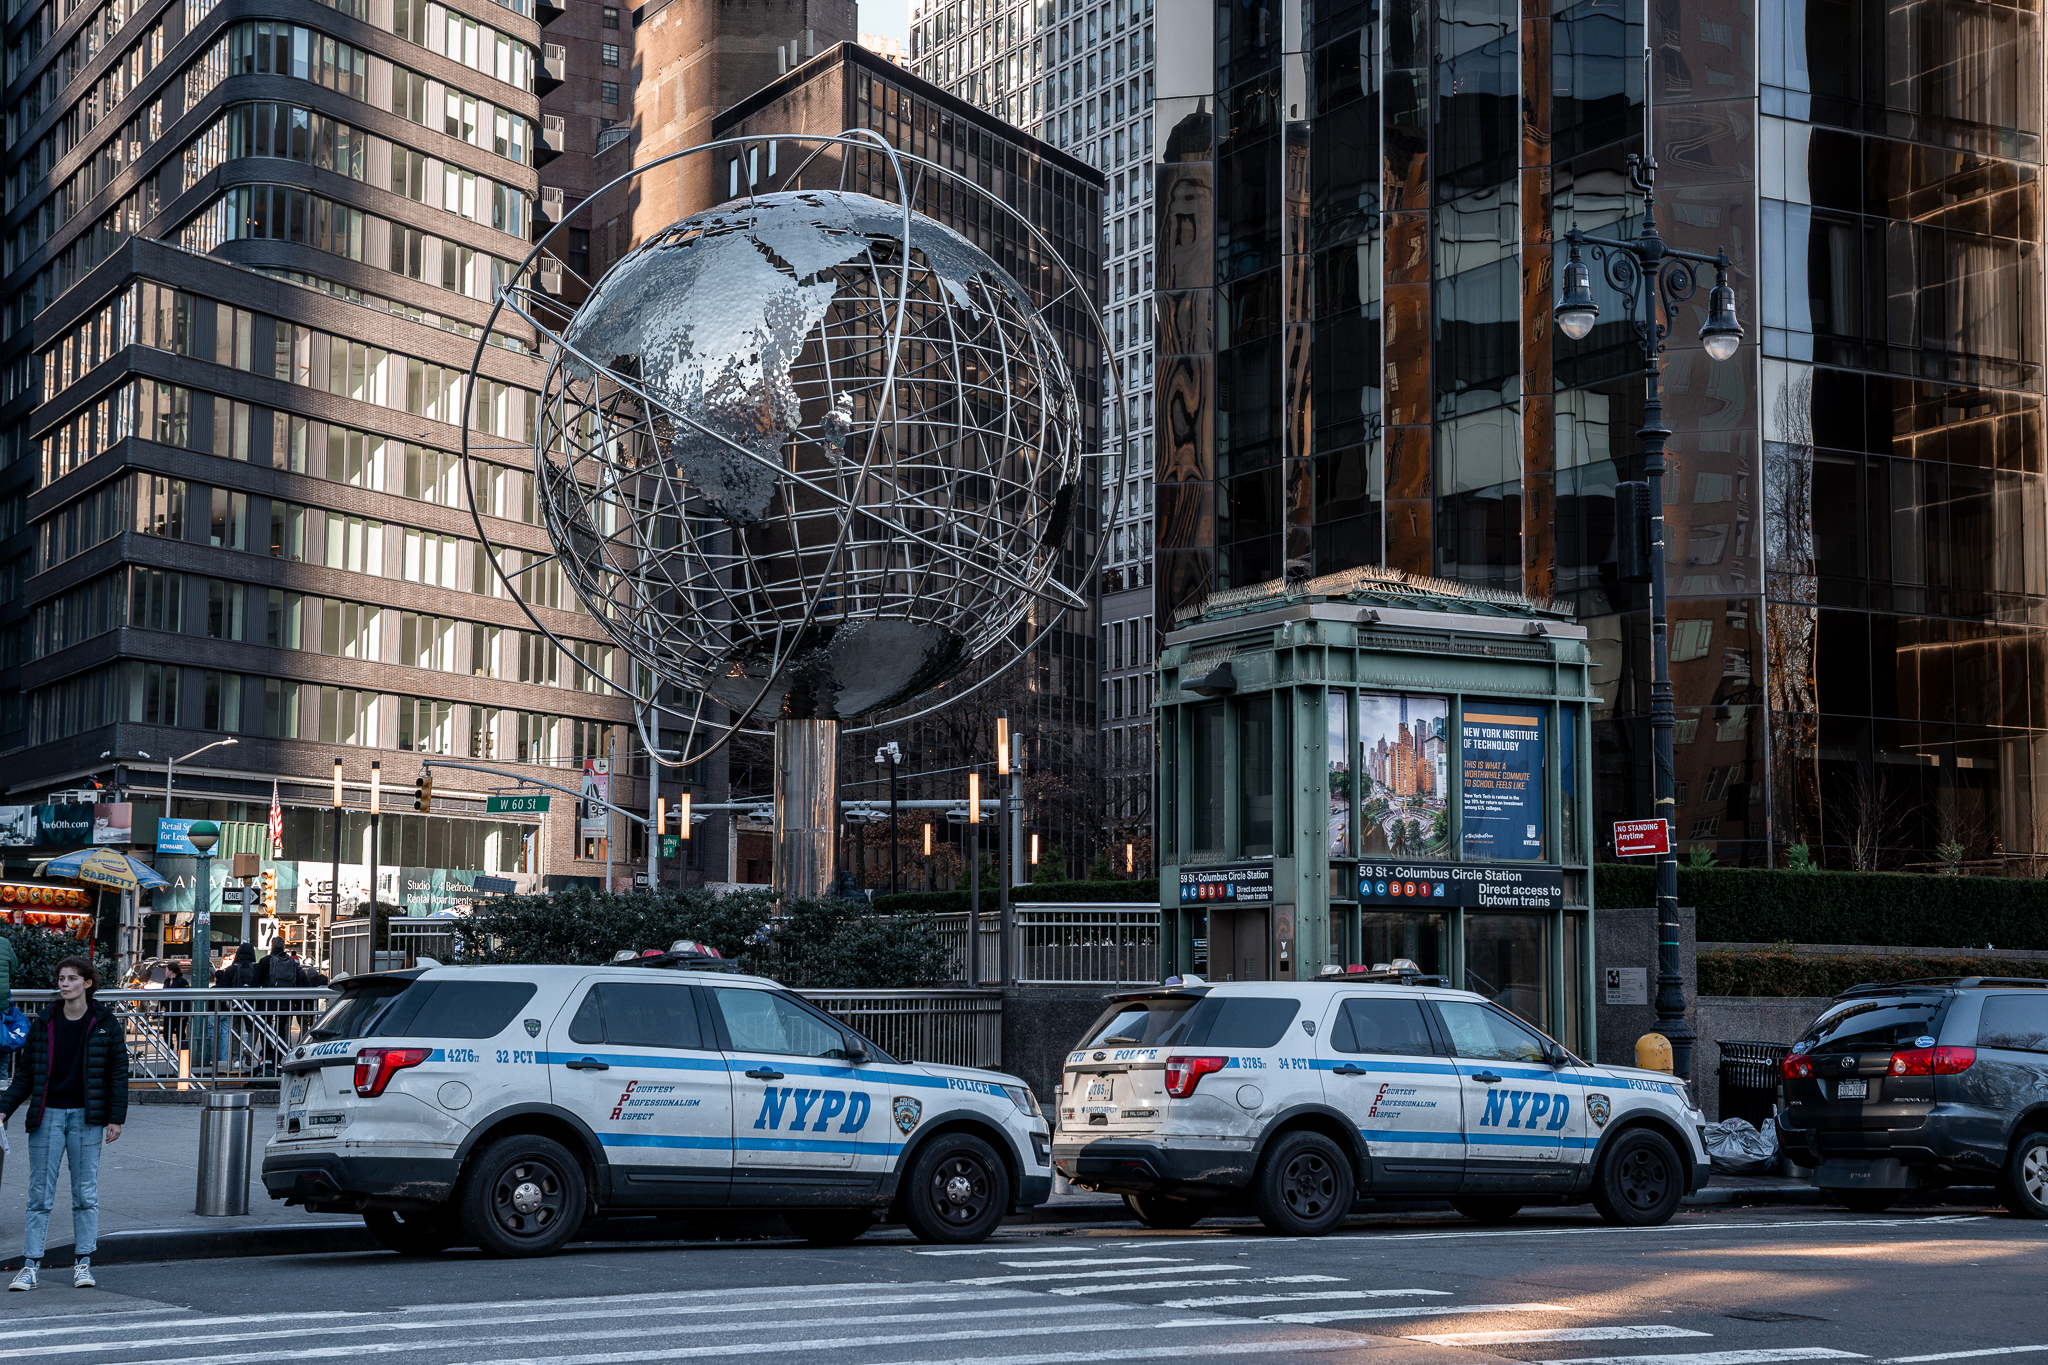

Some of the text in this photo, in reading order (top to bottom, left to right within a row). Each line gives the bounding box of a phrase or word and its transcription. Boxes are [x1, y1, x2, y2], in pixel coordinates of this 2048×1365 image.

[1463, 727, 1538, 740] NEW YORK INSTITUTE
[1464, 738, 1519, 751] OF TECHNOLOGY
[1464, 760, 1476, 768] THIS
[1478, 760, 1484, 769] IS
[1484, 762, 1501, 770] WHAT
[1464, 770, 1530, 781] WORTHWHILE COMMUTE
[1464, 779, 1526, 790] TO SCHOOL FEELS LIKE.
[500, 798, 536, 810] W 60 St
[590, 801, 598, 826] SHO
[162, 822, 182, 830] Retail
[1628, 824, 1658, 832] STANDING
[160, 832, 189, 840] for Leas
[1618, 832, 1644, 841] Anytime
[82, 868, 134, 888] SABRETT
[1180, 874, 1188, 883] 59
[1188, 873, 1195, 882] St
[1198, 872, 1228, 882] Columbus
[1228, 871, 1246, 880] Circle
[1246, 870, 1268, 880] Station
[1359, 866, 1372, 877] 59
[1375, 866, 1387, 878] St
[1395, 867, 1450, 880] Columbus
[1452, 868, 1482, 880] Circle
[1484, 870, 1522, 882] Station
[407, 880, 431, 890] Studio
[438, 882, 444, 891] 4
[1182, 888, 1187, 896] A
[1191, 887, 1196, 896] C
[1200, 887, 1206, 896] B
[1210, 886, 1214, 896] D
[1362, 882, 1427, 894] A C B D 1
[1478, 884, 1561, 896] Direct access to
[407, 893, 474, 907] Rental Apartments
[1478, 894, 1550, 907] Uptown trains
[310, 1042, 352, 1056] POLICE
[1114, 1049, 1158, 1060] POLICE
[496, 1050, 509, 1064] 32
[513, 1050, 533, 1064] PCT
[1068, 1052, 1086, 1062] NYPD
[1242, 1057, 1262, 1069] 3785
[1278, 1058, 1289, 1069] 34
[1291, 1058, 1307, 1070] PCT
[948, 1078, 990, 1094] POLICE
[1629, 1080, 1662, 1092] POLICE
[754, 1087, 871, 1134] NYPD
[1480, 1089, 1570, 1130] NYPD
